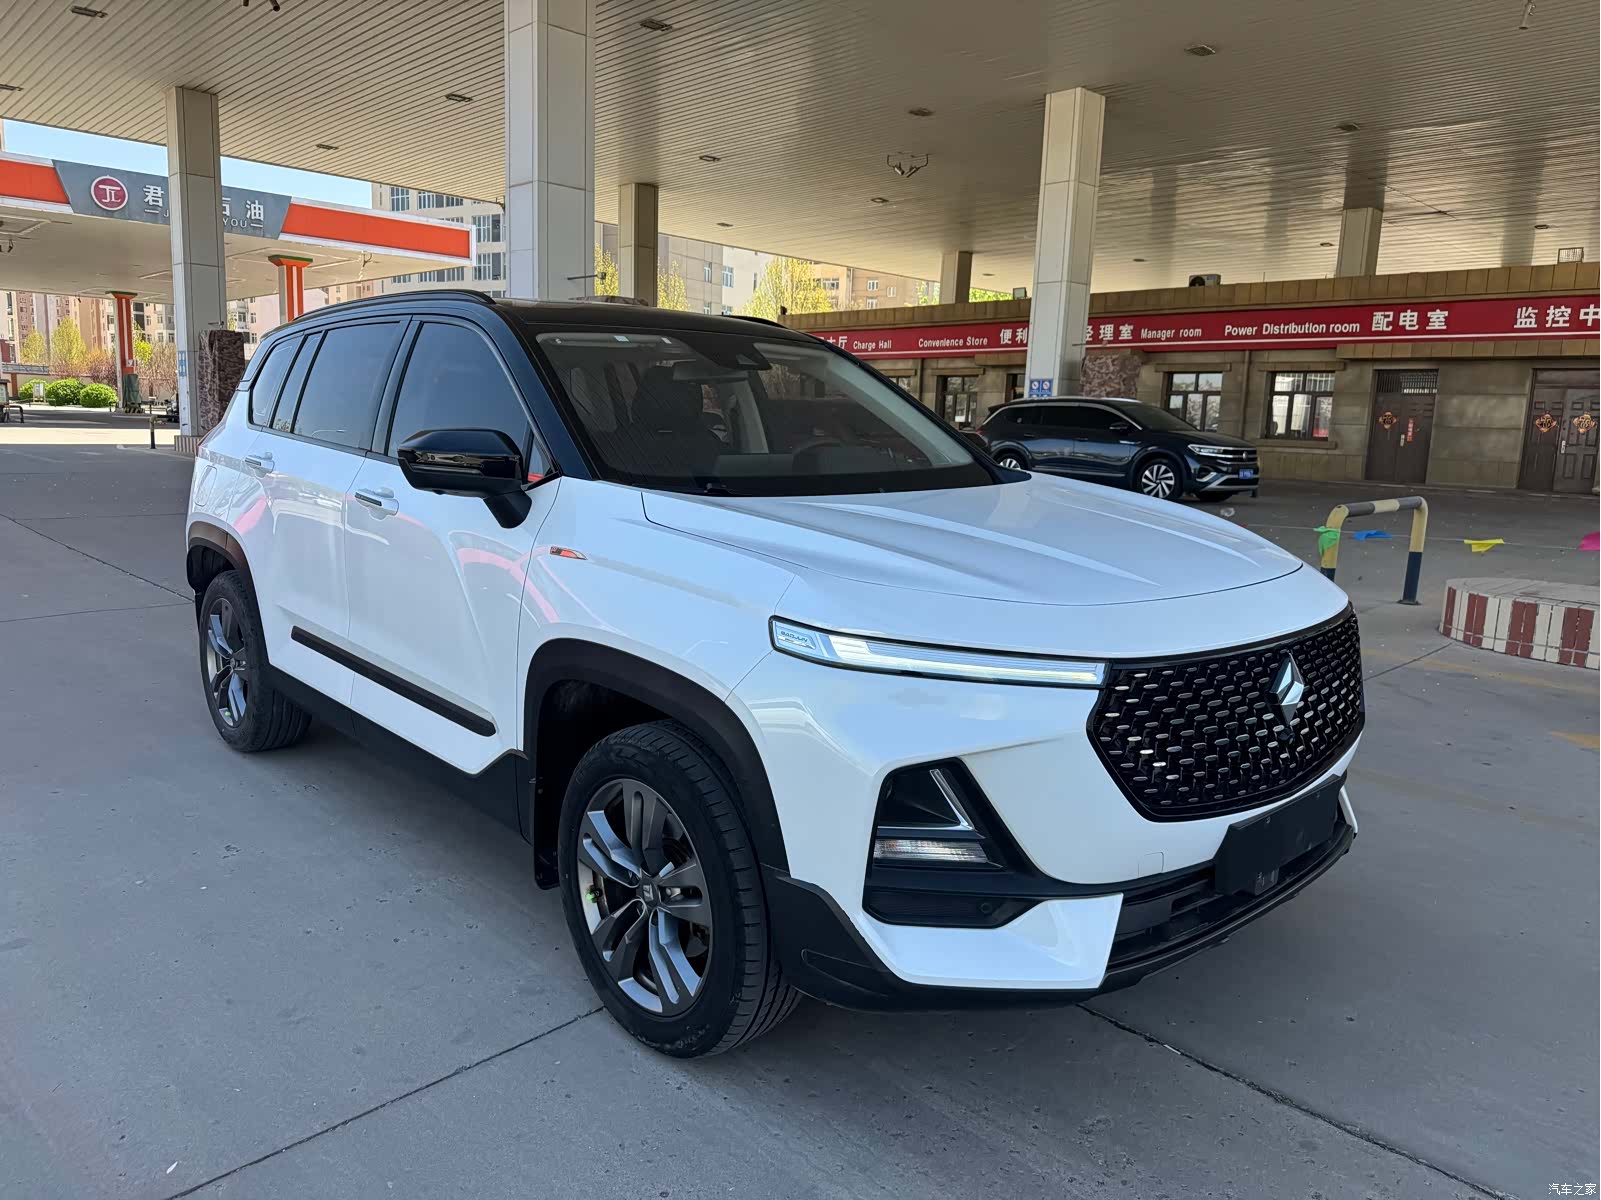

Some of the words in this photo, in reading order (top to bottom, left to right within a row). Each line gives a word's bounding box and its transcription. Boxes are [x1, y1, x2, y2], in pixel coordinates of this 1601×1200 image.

[1224, 324, 1258, 337] Power
[1262, 321, 1327, 335] Distribution
[1329, 322, 1360, 333] room
[1371, 308, 1449, 332] 配电室
[1513, 303, 1600, 328] 监控中
[918, 337, 964, 348] Convenience
[965, 336, 988, 346] Store
[999, 327, 1028, 345] 便利
[1140, 327, 1175, 341] Manager
[1179, 326, 1202, 338] room
[853, 340, 876, 351] Charge
[878, 339, 892, 349] Hall
